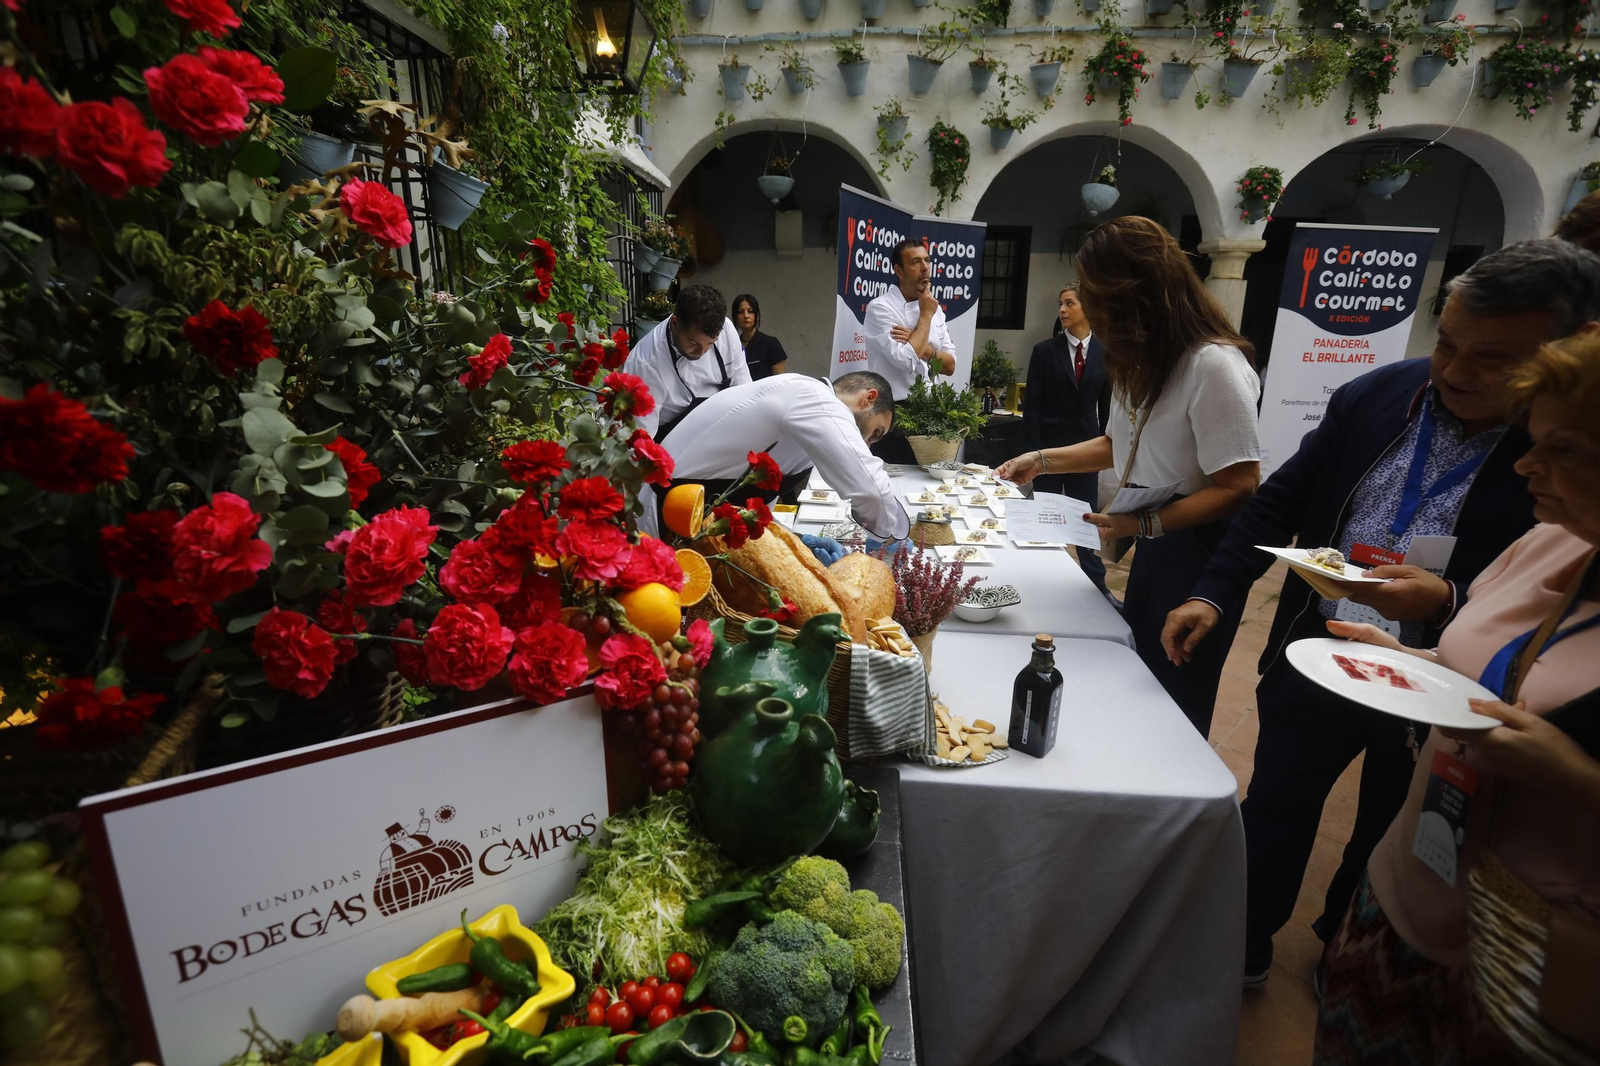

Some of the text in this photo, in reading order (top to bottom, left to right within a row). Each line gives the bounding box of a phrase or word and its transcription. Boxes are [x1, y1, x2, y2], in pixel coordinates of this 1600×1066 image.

[853, 276, 894, 298] Gourm
[1319, 267, 1412, 290] Califato
[1314, 292, 1406, 312] Gourmet
[1336, 313, 1370, 323] EDICIÓN
[1313, 337, 1370, 349] PANADERÍA
[1302, 353, 1375, 364] EL BRILLANTE
[1303, 413, 1321, 421] José
[1370, 553, 1396, 565] PRENSA
[479, 807, 557, 840] EN 1908
[478, 812, 598, 877] CAMPOS
[240, 869, 362, 917] FUNDADAS
[169, 893, 367, 985] BODEGAS
